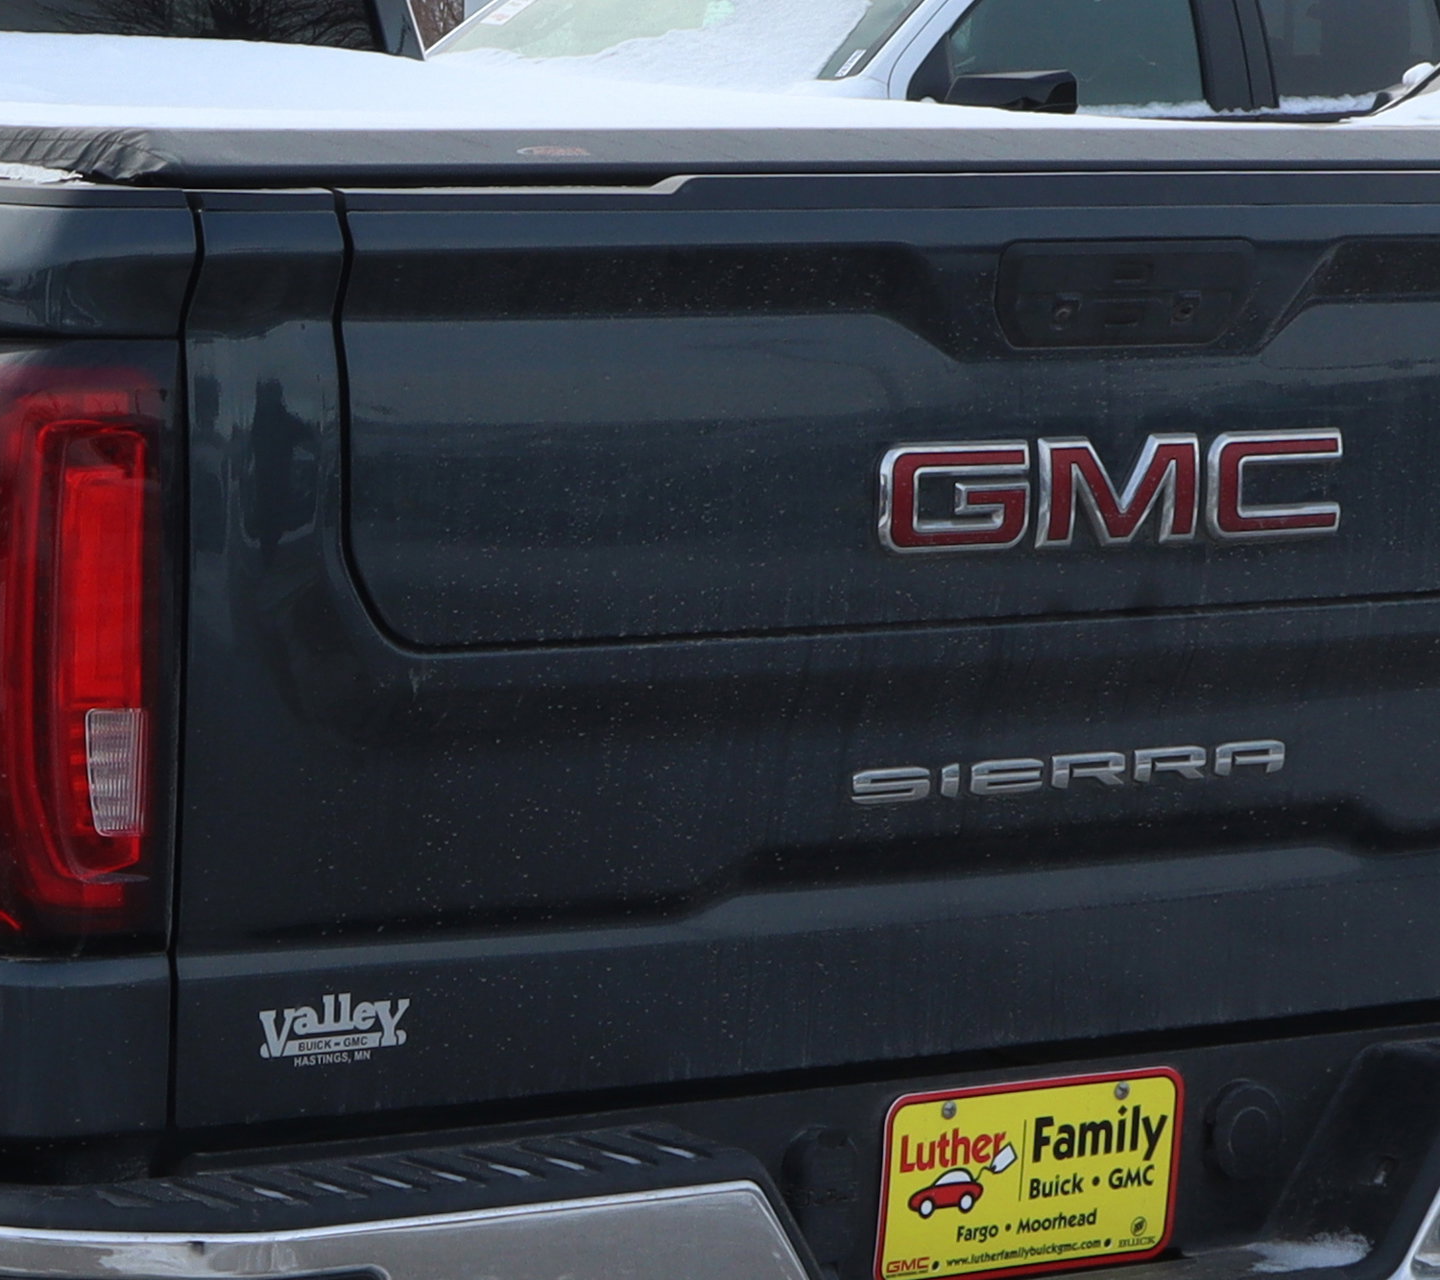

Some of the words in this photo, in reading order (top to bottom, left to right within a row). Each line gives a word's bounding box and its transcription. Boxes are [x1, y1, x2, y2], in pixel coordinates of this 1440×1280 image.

[877, 427, 1343, 554] GMC
[851, 738, 1286, 806] SIERRA
[259, 993, 410, 1058] Valley
[298, 1040, 332, 1052] BUICK
[343, 1036, 368, 1048] GMC
[354, 1051, 371, 1061] MN
[899, 1128, 1007, 1173] Luther
[1032, 1105, 1168, 1163] Family
[1029, 1173, 1083, 1200] Buick
[1108, 1164, 1155, 1190] GMC
[956, 1224, 999, 1243] Fargo
[1017, 1208, 1097, 1235] Moorhead
[886, 1257, 930, 1273] GMC
[946, 1239, 1101, 1268] www.lutherfamilybuickgmc.com
